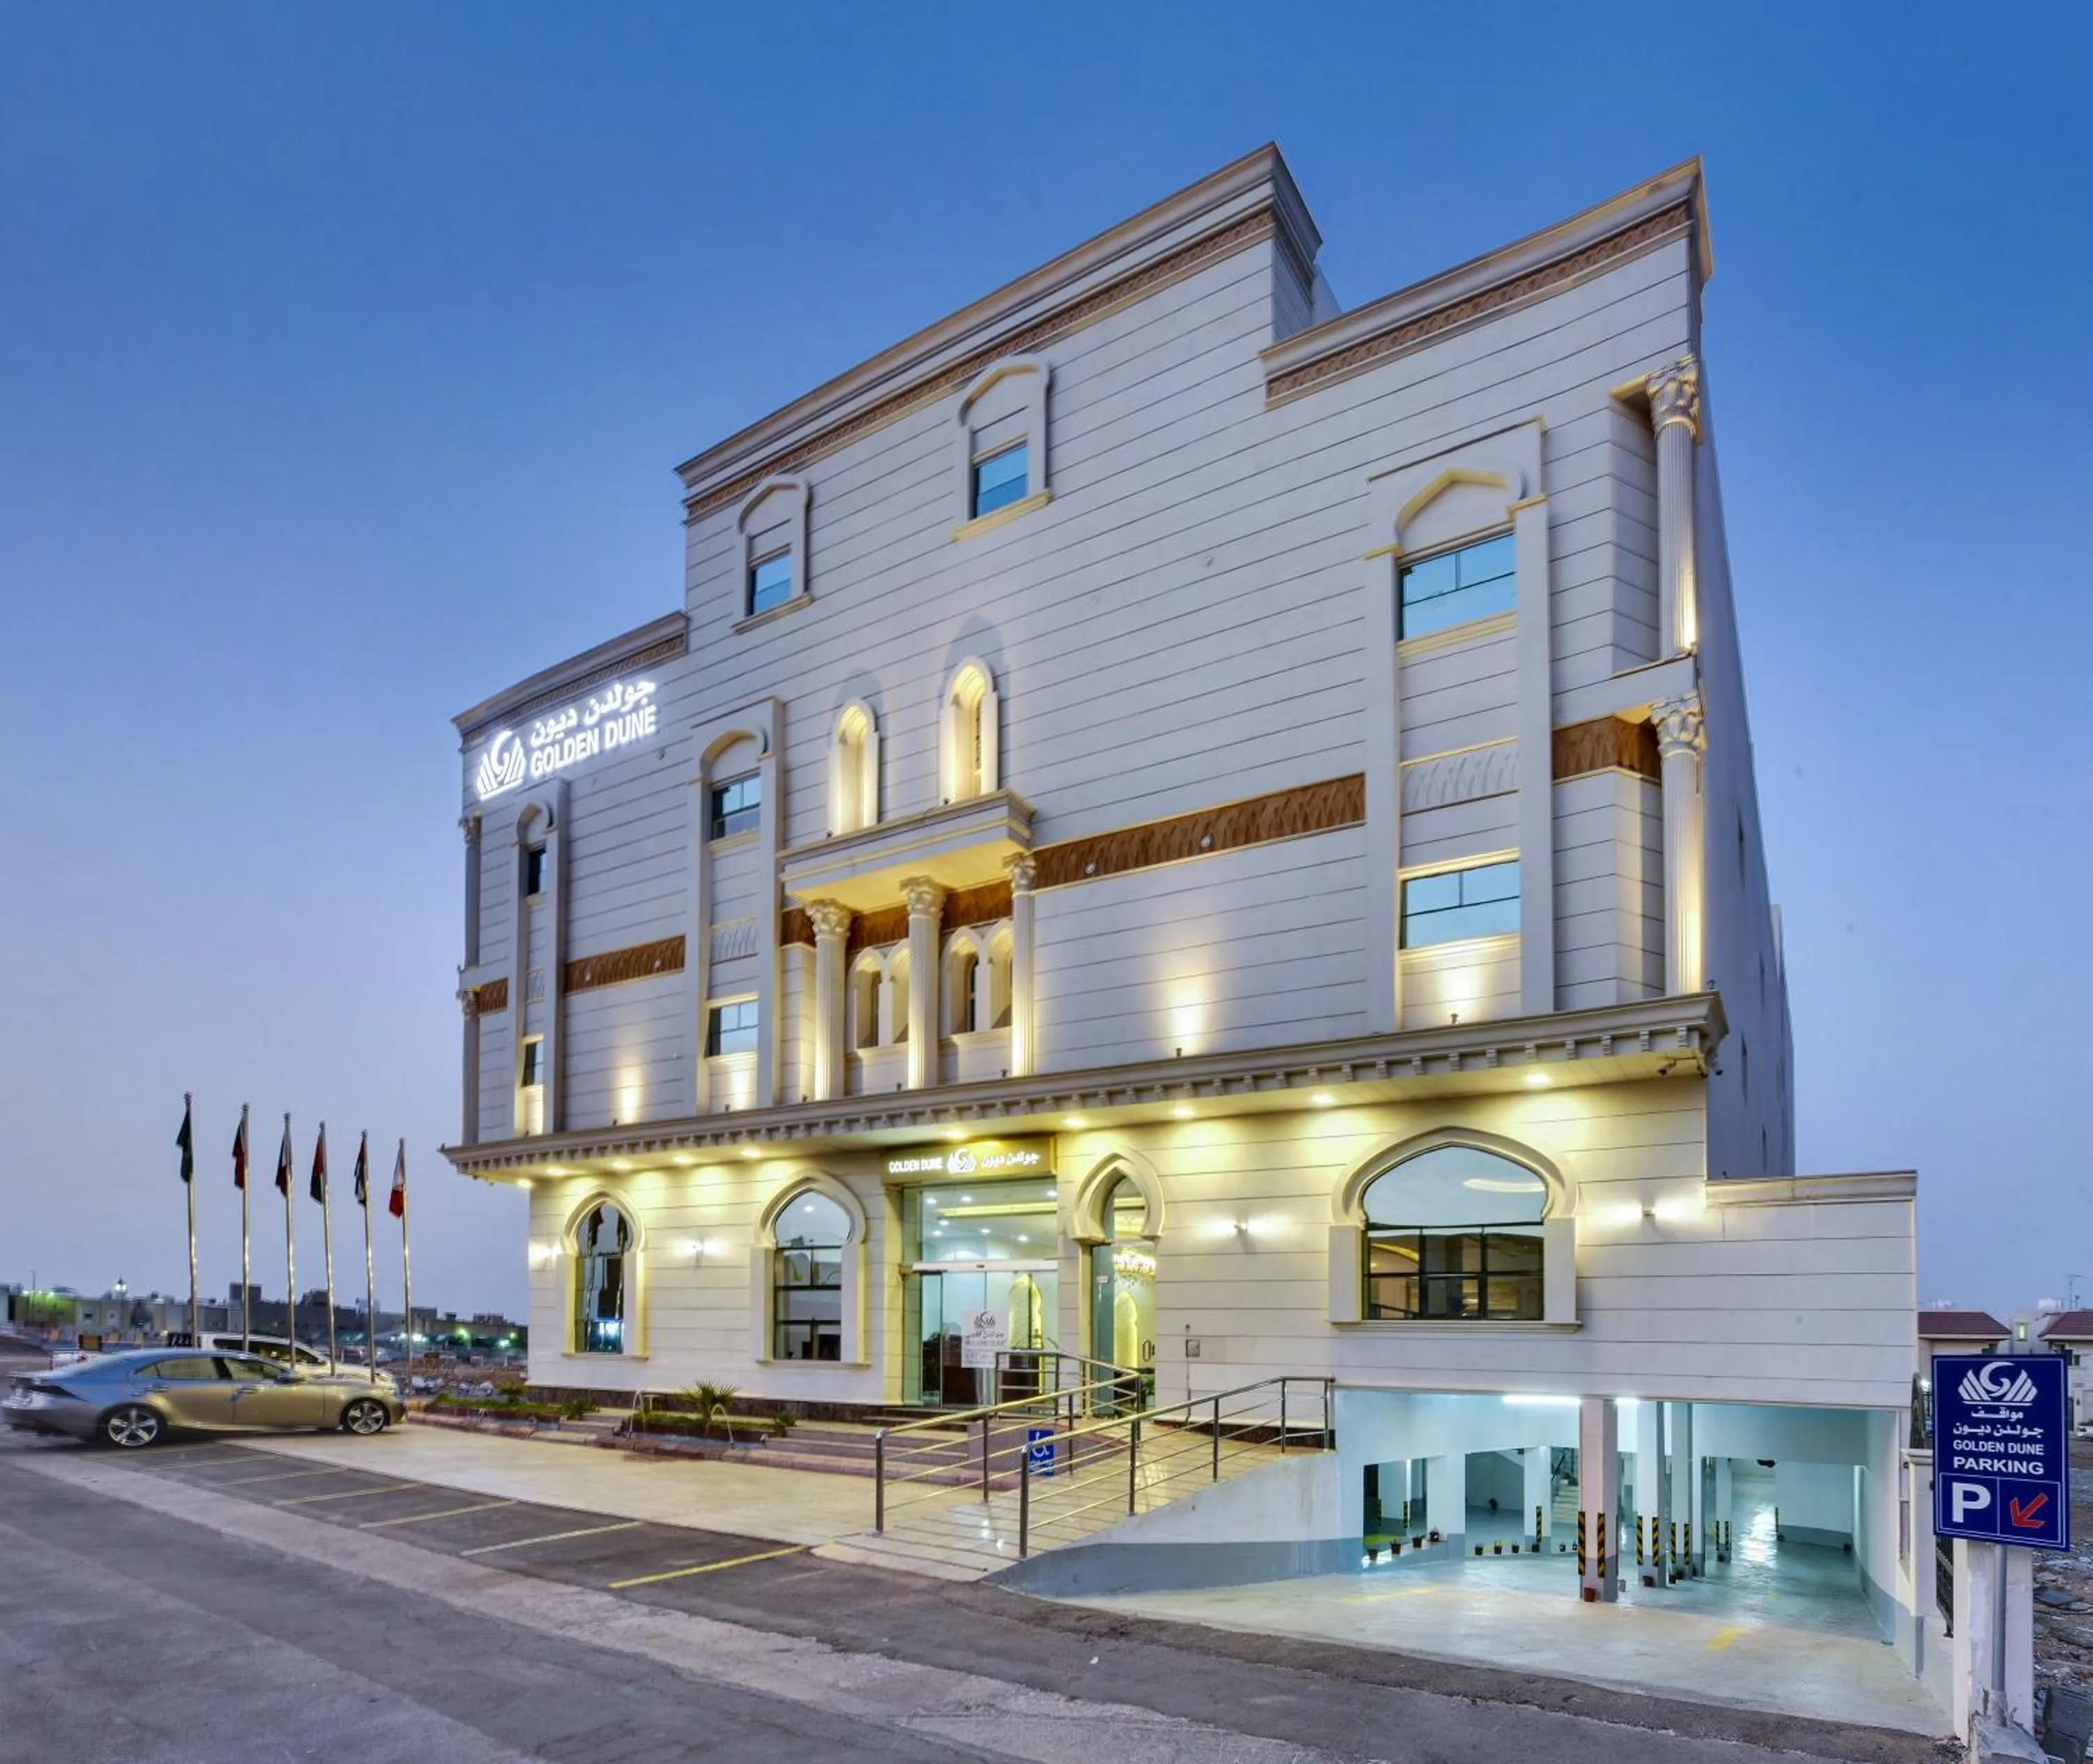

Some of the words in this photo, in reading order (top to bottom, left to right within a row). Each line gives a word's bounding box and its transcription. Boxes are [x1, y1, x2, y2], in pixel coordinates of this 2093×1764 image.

[584, 681, 657, 726] جولدن
[530, 708, 578, 747] ديون
[530, 728, 599, 777] GOLDEN
[605, 705, 657, 749] DUNE
[889, 1160, 920, 1173] GOLDEN
[1971, 1406, 2024, 1422] مواقف
[1953, 1423, 1992, 1435] ديون
[1993, 1424, 2043, 1438] جولدن
[1953, 1440, 2004, 1453] GOLDEN
[2007, 1442, 2045, 1456] DUNE
[1953, 1456, 2044, 1475] PARKING
[1952, 1481, 1991, 1523] P
